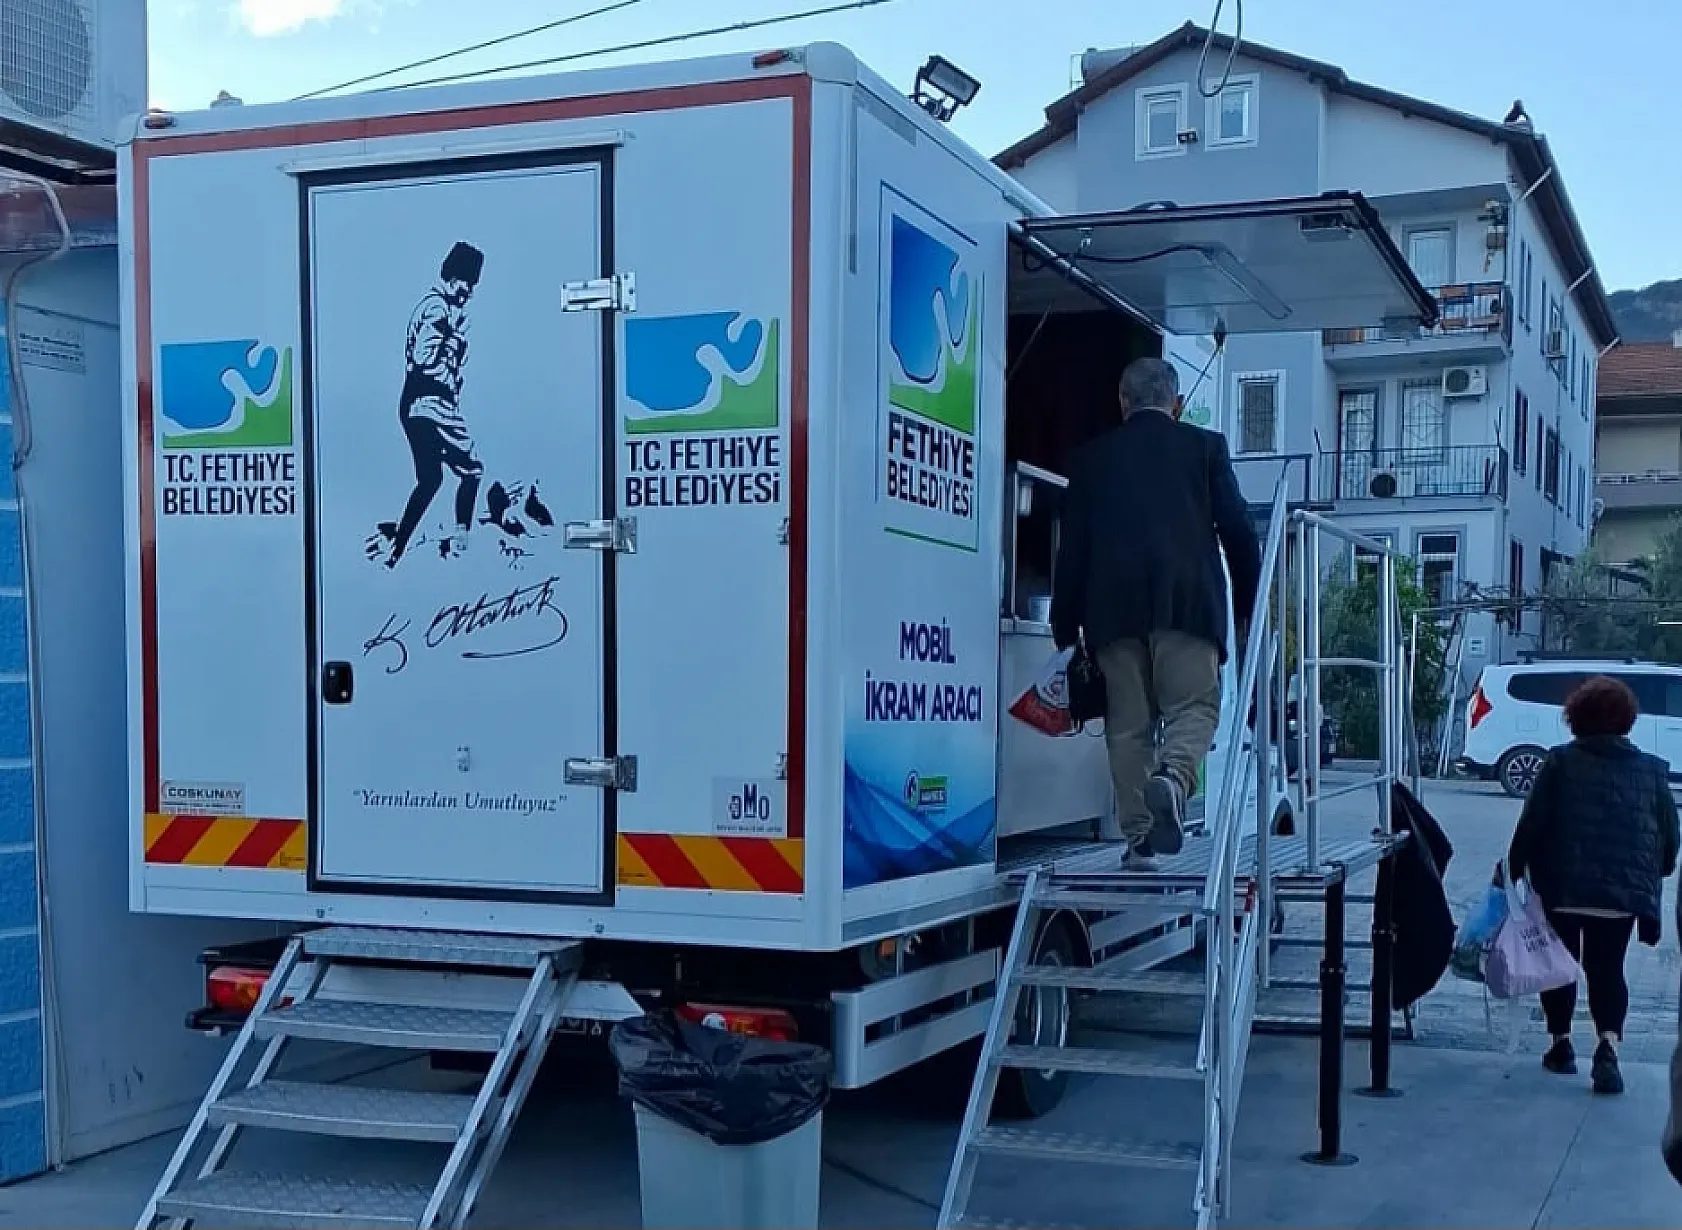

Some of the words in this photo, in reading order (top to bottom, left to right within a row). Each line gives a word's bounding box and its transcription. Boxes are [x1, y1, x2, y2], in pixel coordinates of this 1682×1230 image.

[162, 454, 198, 482] T.C.
[625, 440, 666, 472] T.C.
[899, 616, 957, 665] MOBİL
[865, 668, 926, 722] İKRAM
[930, 683, 982, 722] ARACI
